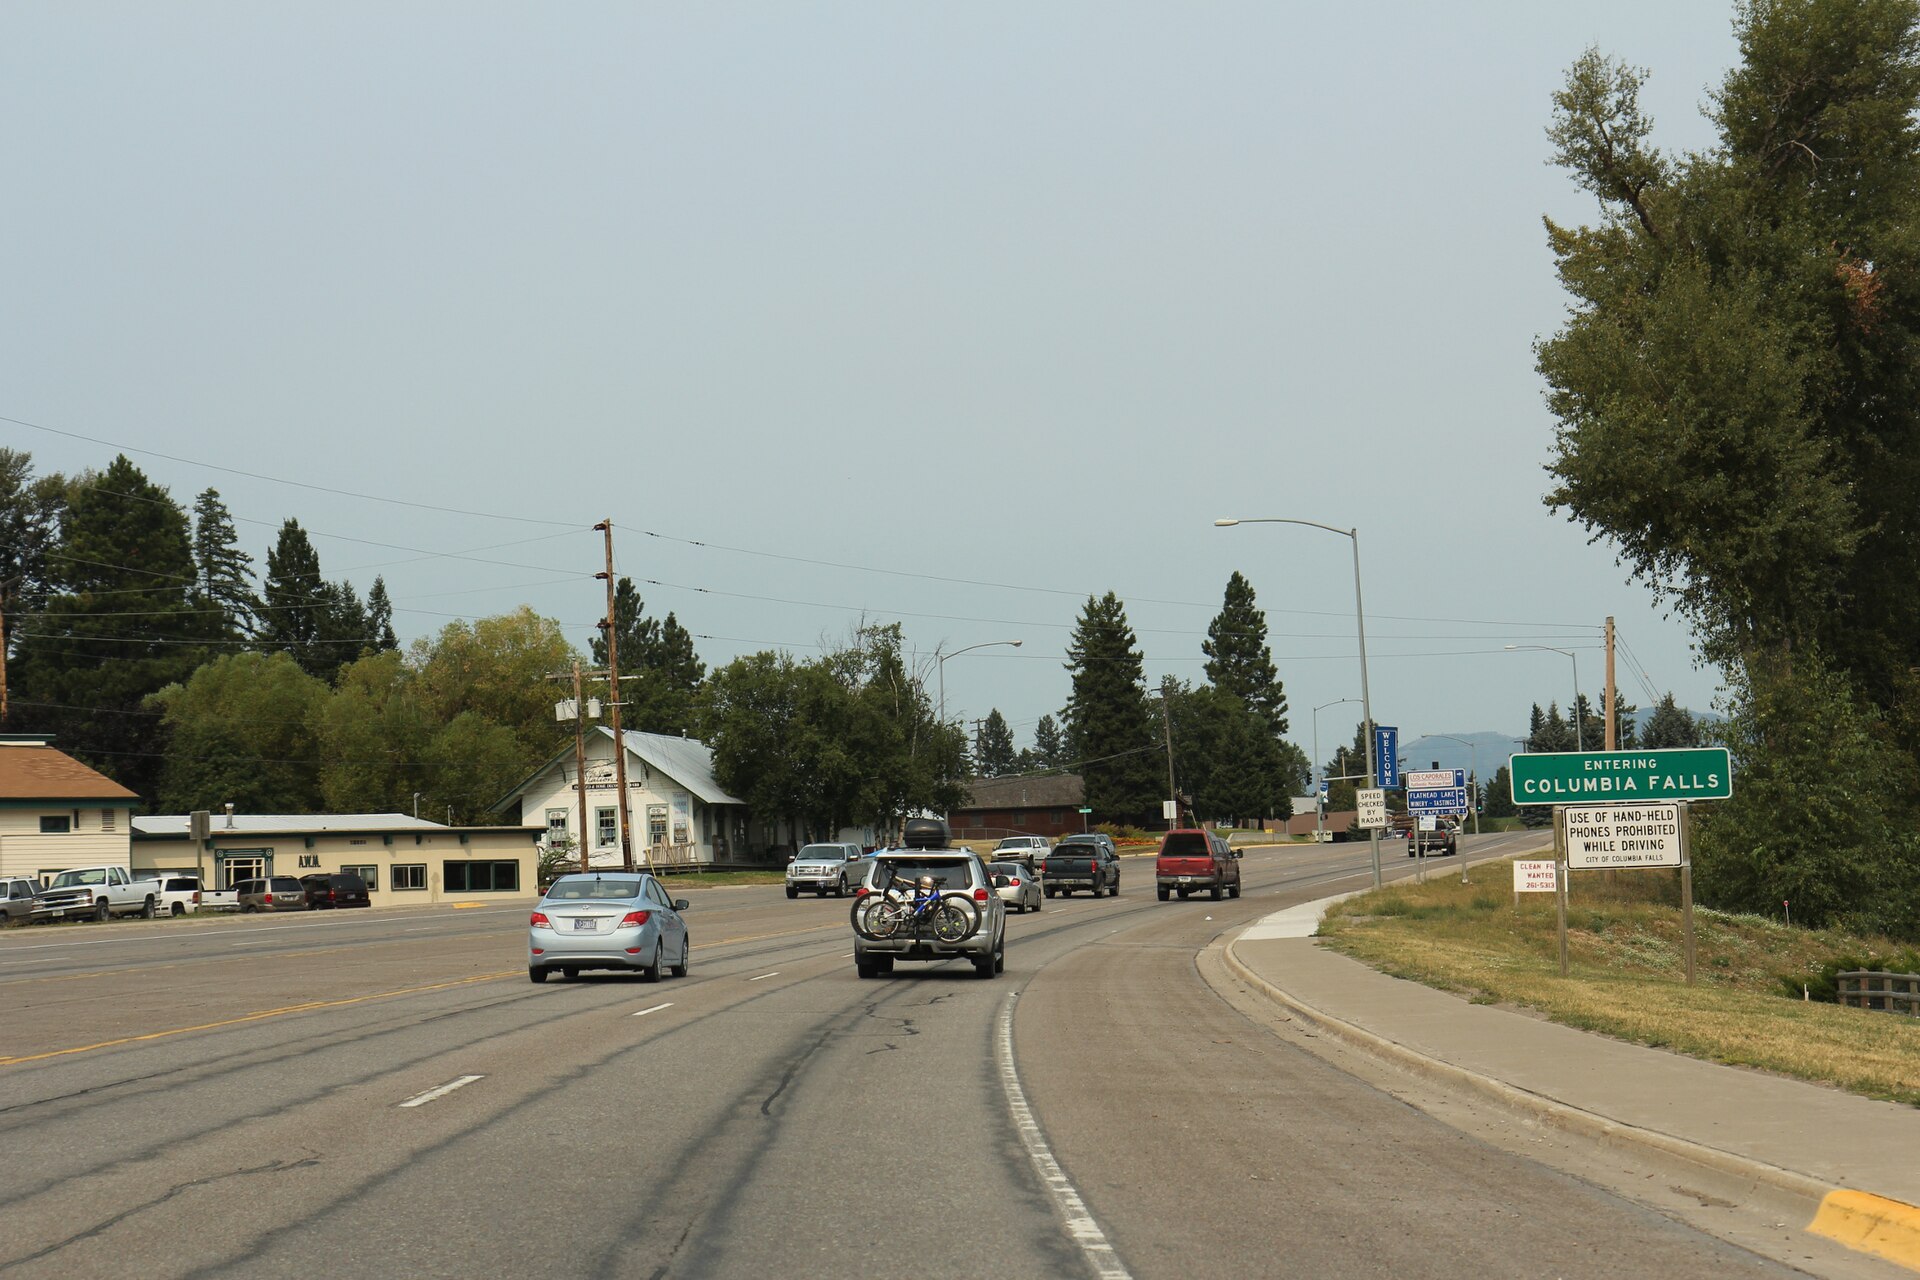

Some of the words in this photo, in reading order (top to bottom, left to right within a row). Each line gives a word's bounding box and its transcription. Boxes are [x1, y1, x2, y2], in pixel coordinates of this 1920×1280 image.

[1382, 732, 1391, 785] WELCOME
[1584, 759, 1657, 771] ENTERING
[1524, 776, 1637, 793] COLUMBIA
[1649, 774, 1719, 789] FALLS
[1570, 813, 1589, 823] USE
[1595, 812, 1607, 822] OF
[1614, 810, 1673, 821] HAND-HELD
[1570, 827, 1610, 837] PHONES
[1616, 825, 1675, 836] PROHIBITED
[1584, 841, 1615, 851] WHILE
[1622, 840, 1664, 850] DRIVING
